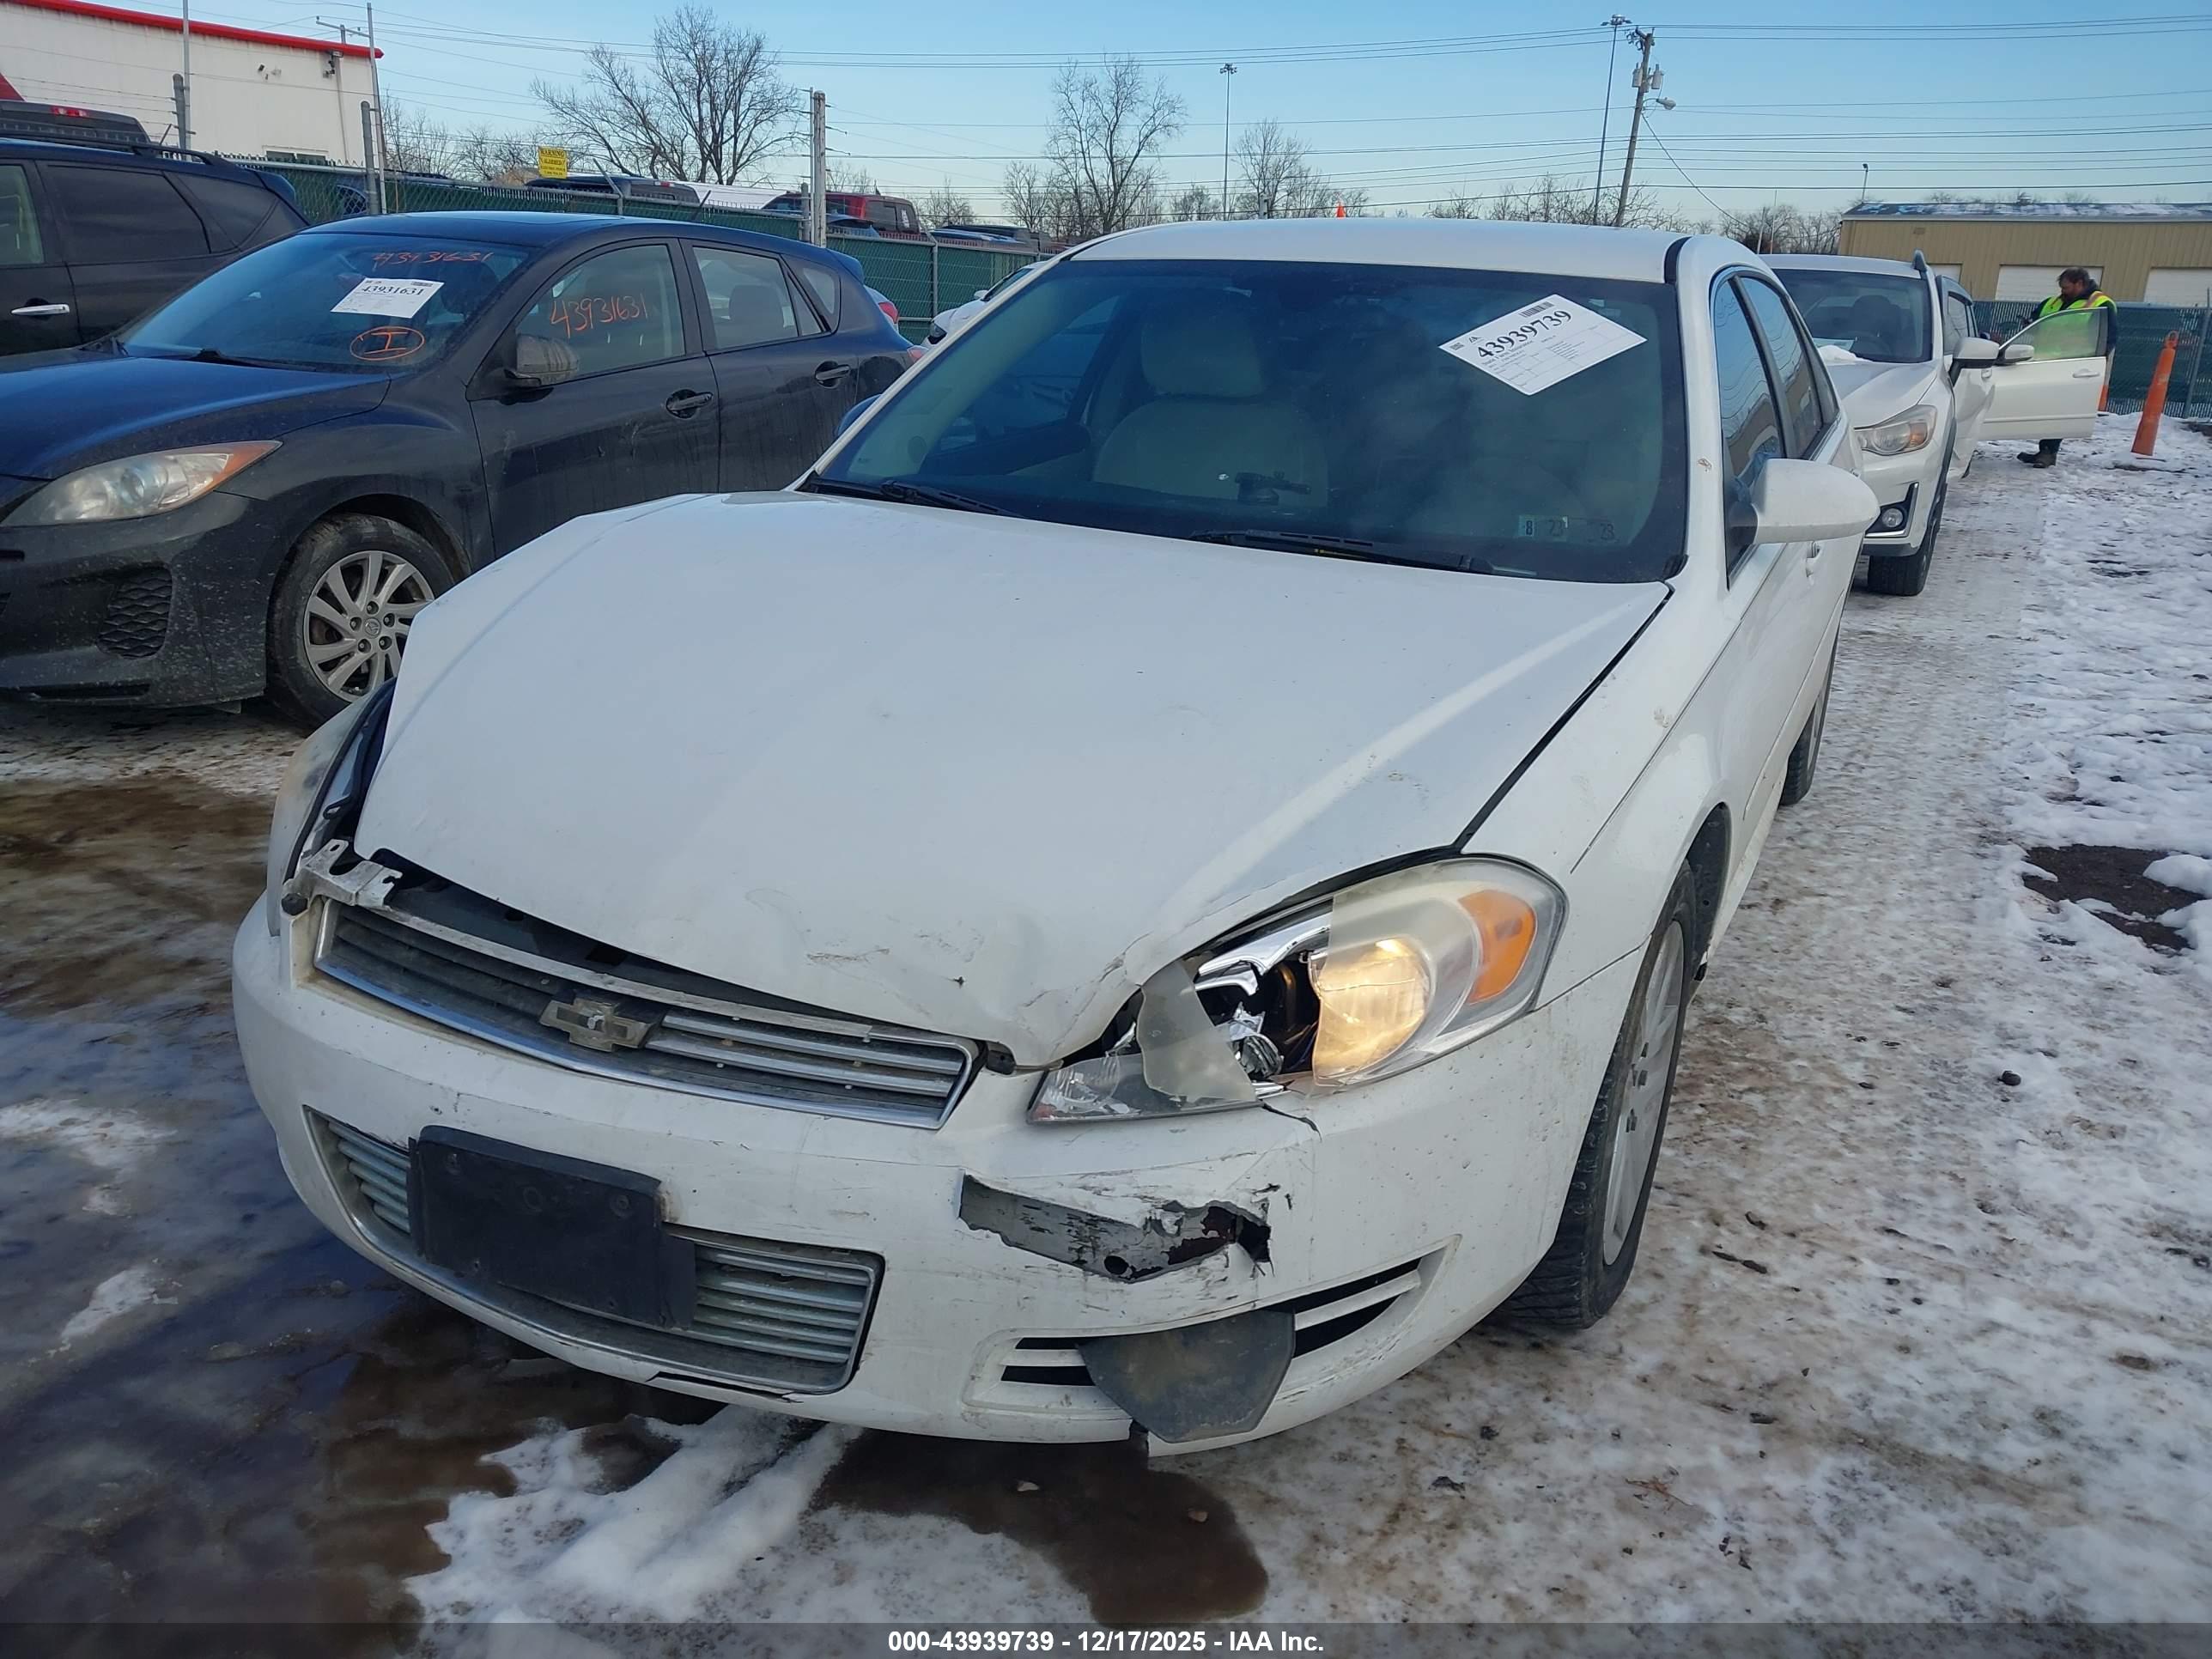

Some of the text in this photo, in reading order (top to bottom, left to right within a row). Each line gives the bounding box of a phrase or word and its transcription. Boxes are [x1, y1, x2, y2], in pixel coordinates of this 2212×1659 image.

[362, 284, 424, 296] 43931631
[551, 293, 648, 339] 43931631
[1477, 310, 1572, 359] 43939739
[1525, 520, 1534, 535] 8
